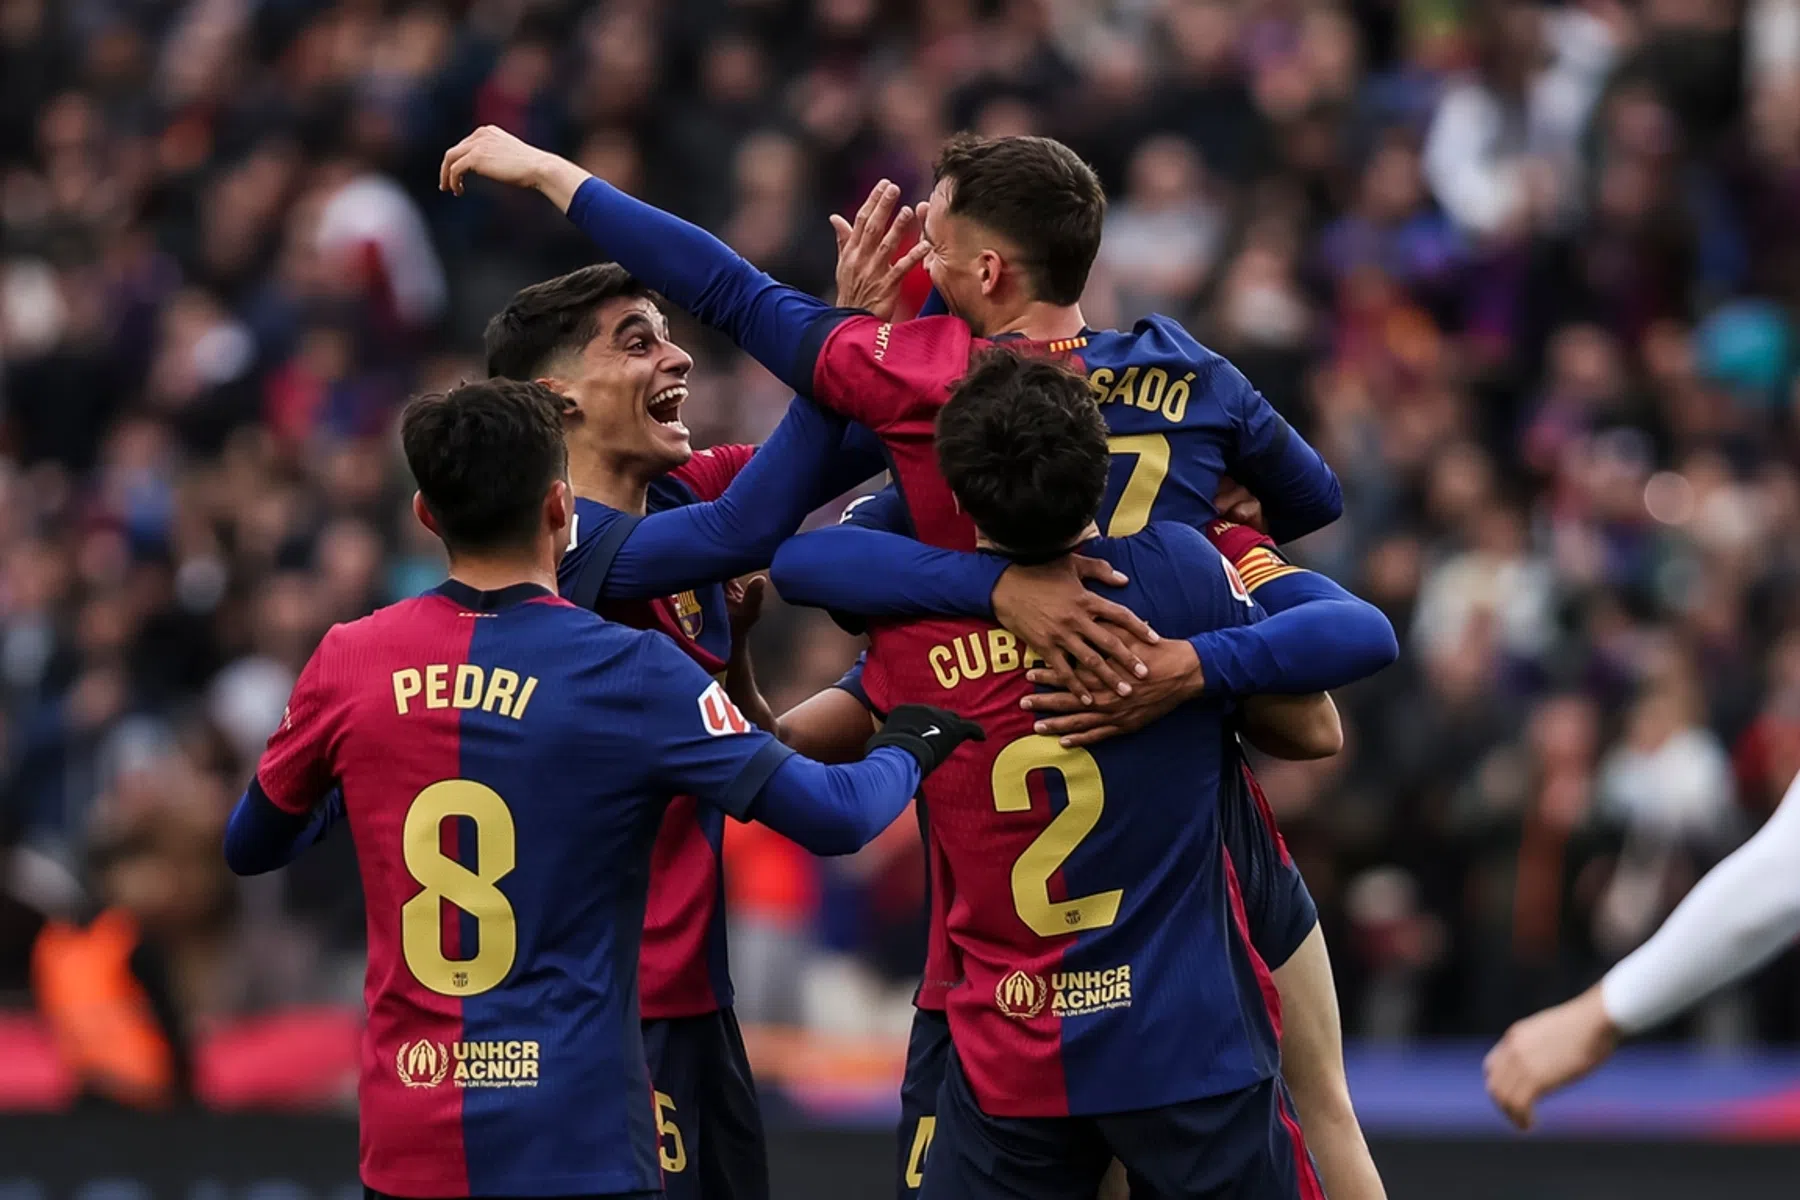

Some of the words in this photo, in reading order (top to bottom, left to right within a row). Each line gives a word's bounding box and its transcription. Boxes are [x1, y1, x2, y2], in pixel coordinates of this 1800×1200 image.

[1090, 367, 1197, 424] SADÓ
[1107, 433, 1171, 539] 7
[392, 664, 539, 720] PEDRI
[991, 734, 1124, 937] 2
[402, 779, 517, 996] 8
[1051, 964, 1131, 990] UNHCR
[1051, 981, 1132, 1009] ACNUR
[453, 1041, 539, 1060] UNHCR
[453, 1060, 539, 1079] ACNUR
[654, 1090, 687, 1173] 5
